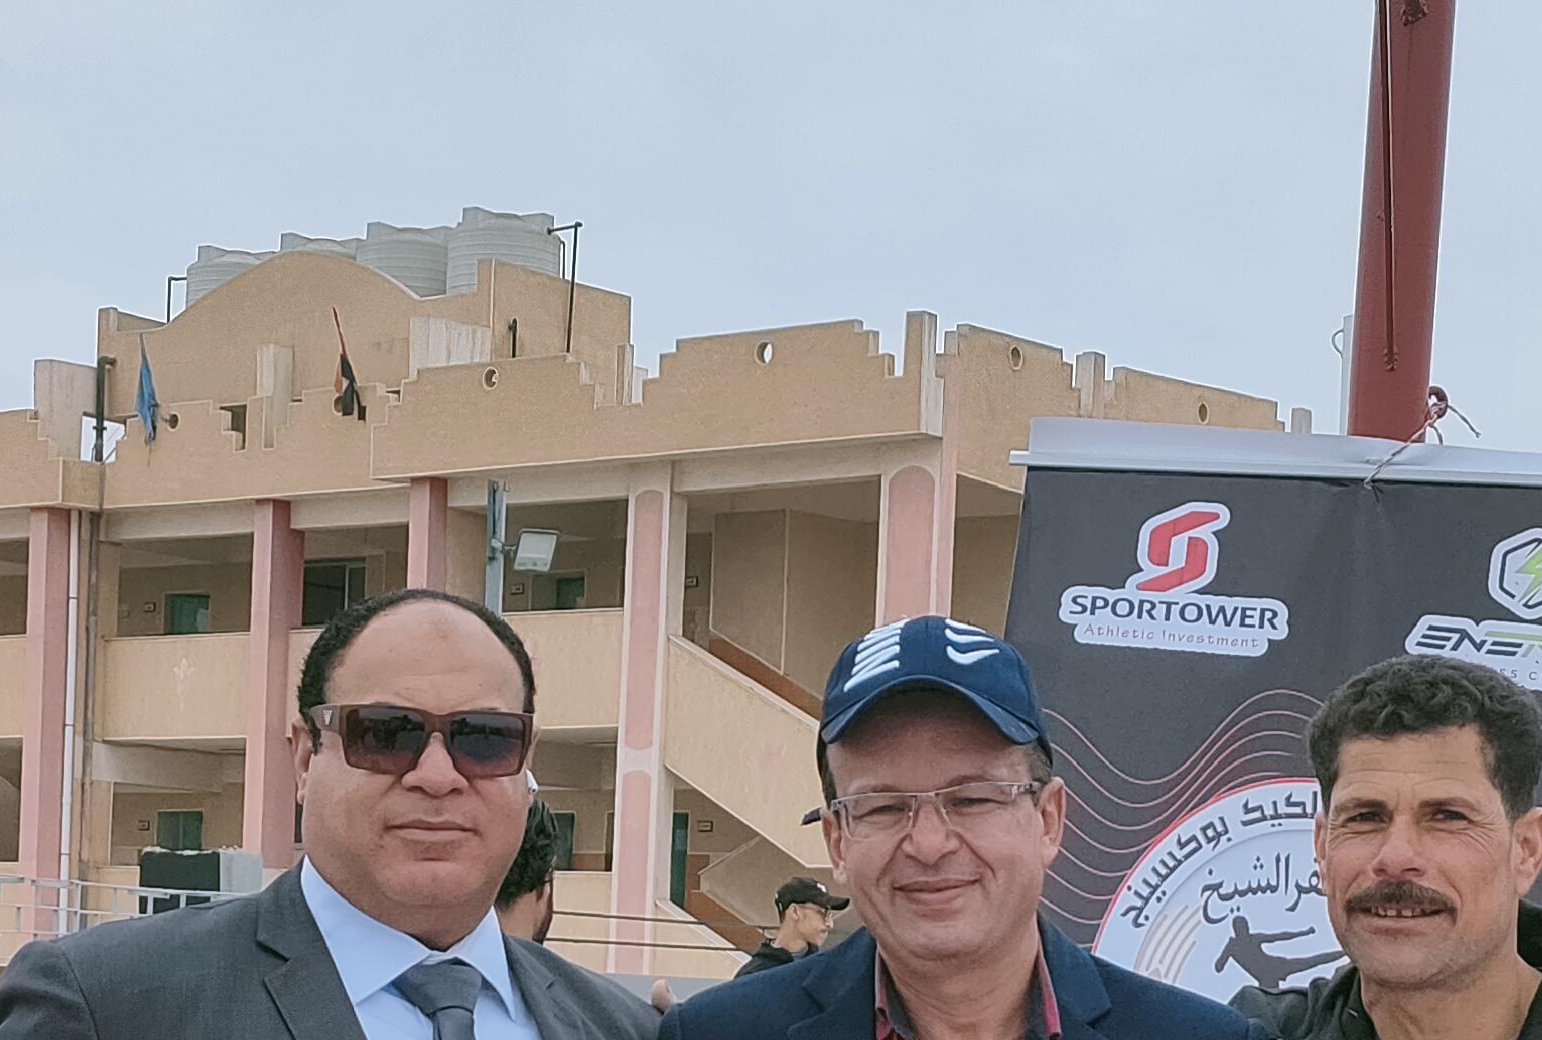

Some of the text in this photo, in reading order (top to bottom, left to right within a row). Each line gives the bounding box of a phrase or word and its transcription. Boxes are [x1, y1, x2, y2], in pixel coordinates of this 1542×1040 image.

[1068, 594, 1280, 631] SPORTOWER
[1083, 622, 1260, 648] Athletic Investment
[1119, 790, 1319, 929] لكيك بوكسينج
[1200, 852, 1291, 925] الشيخ
